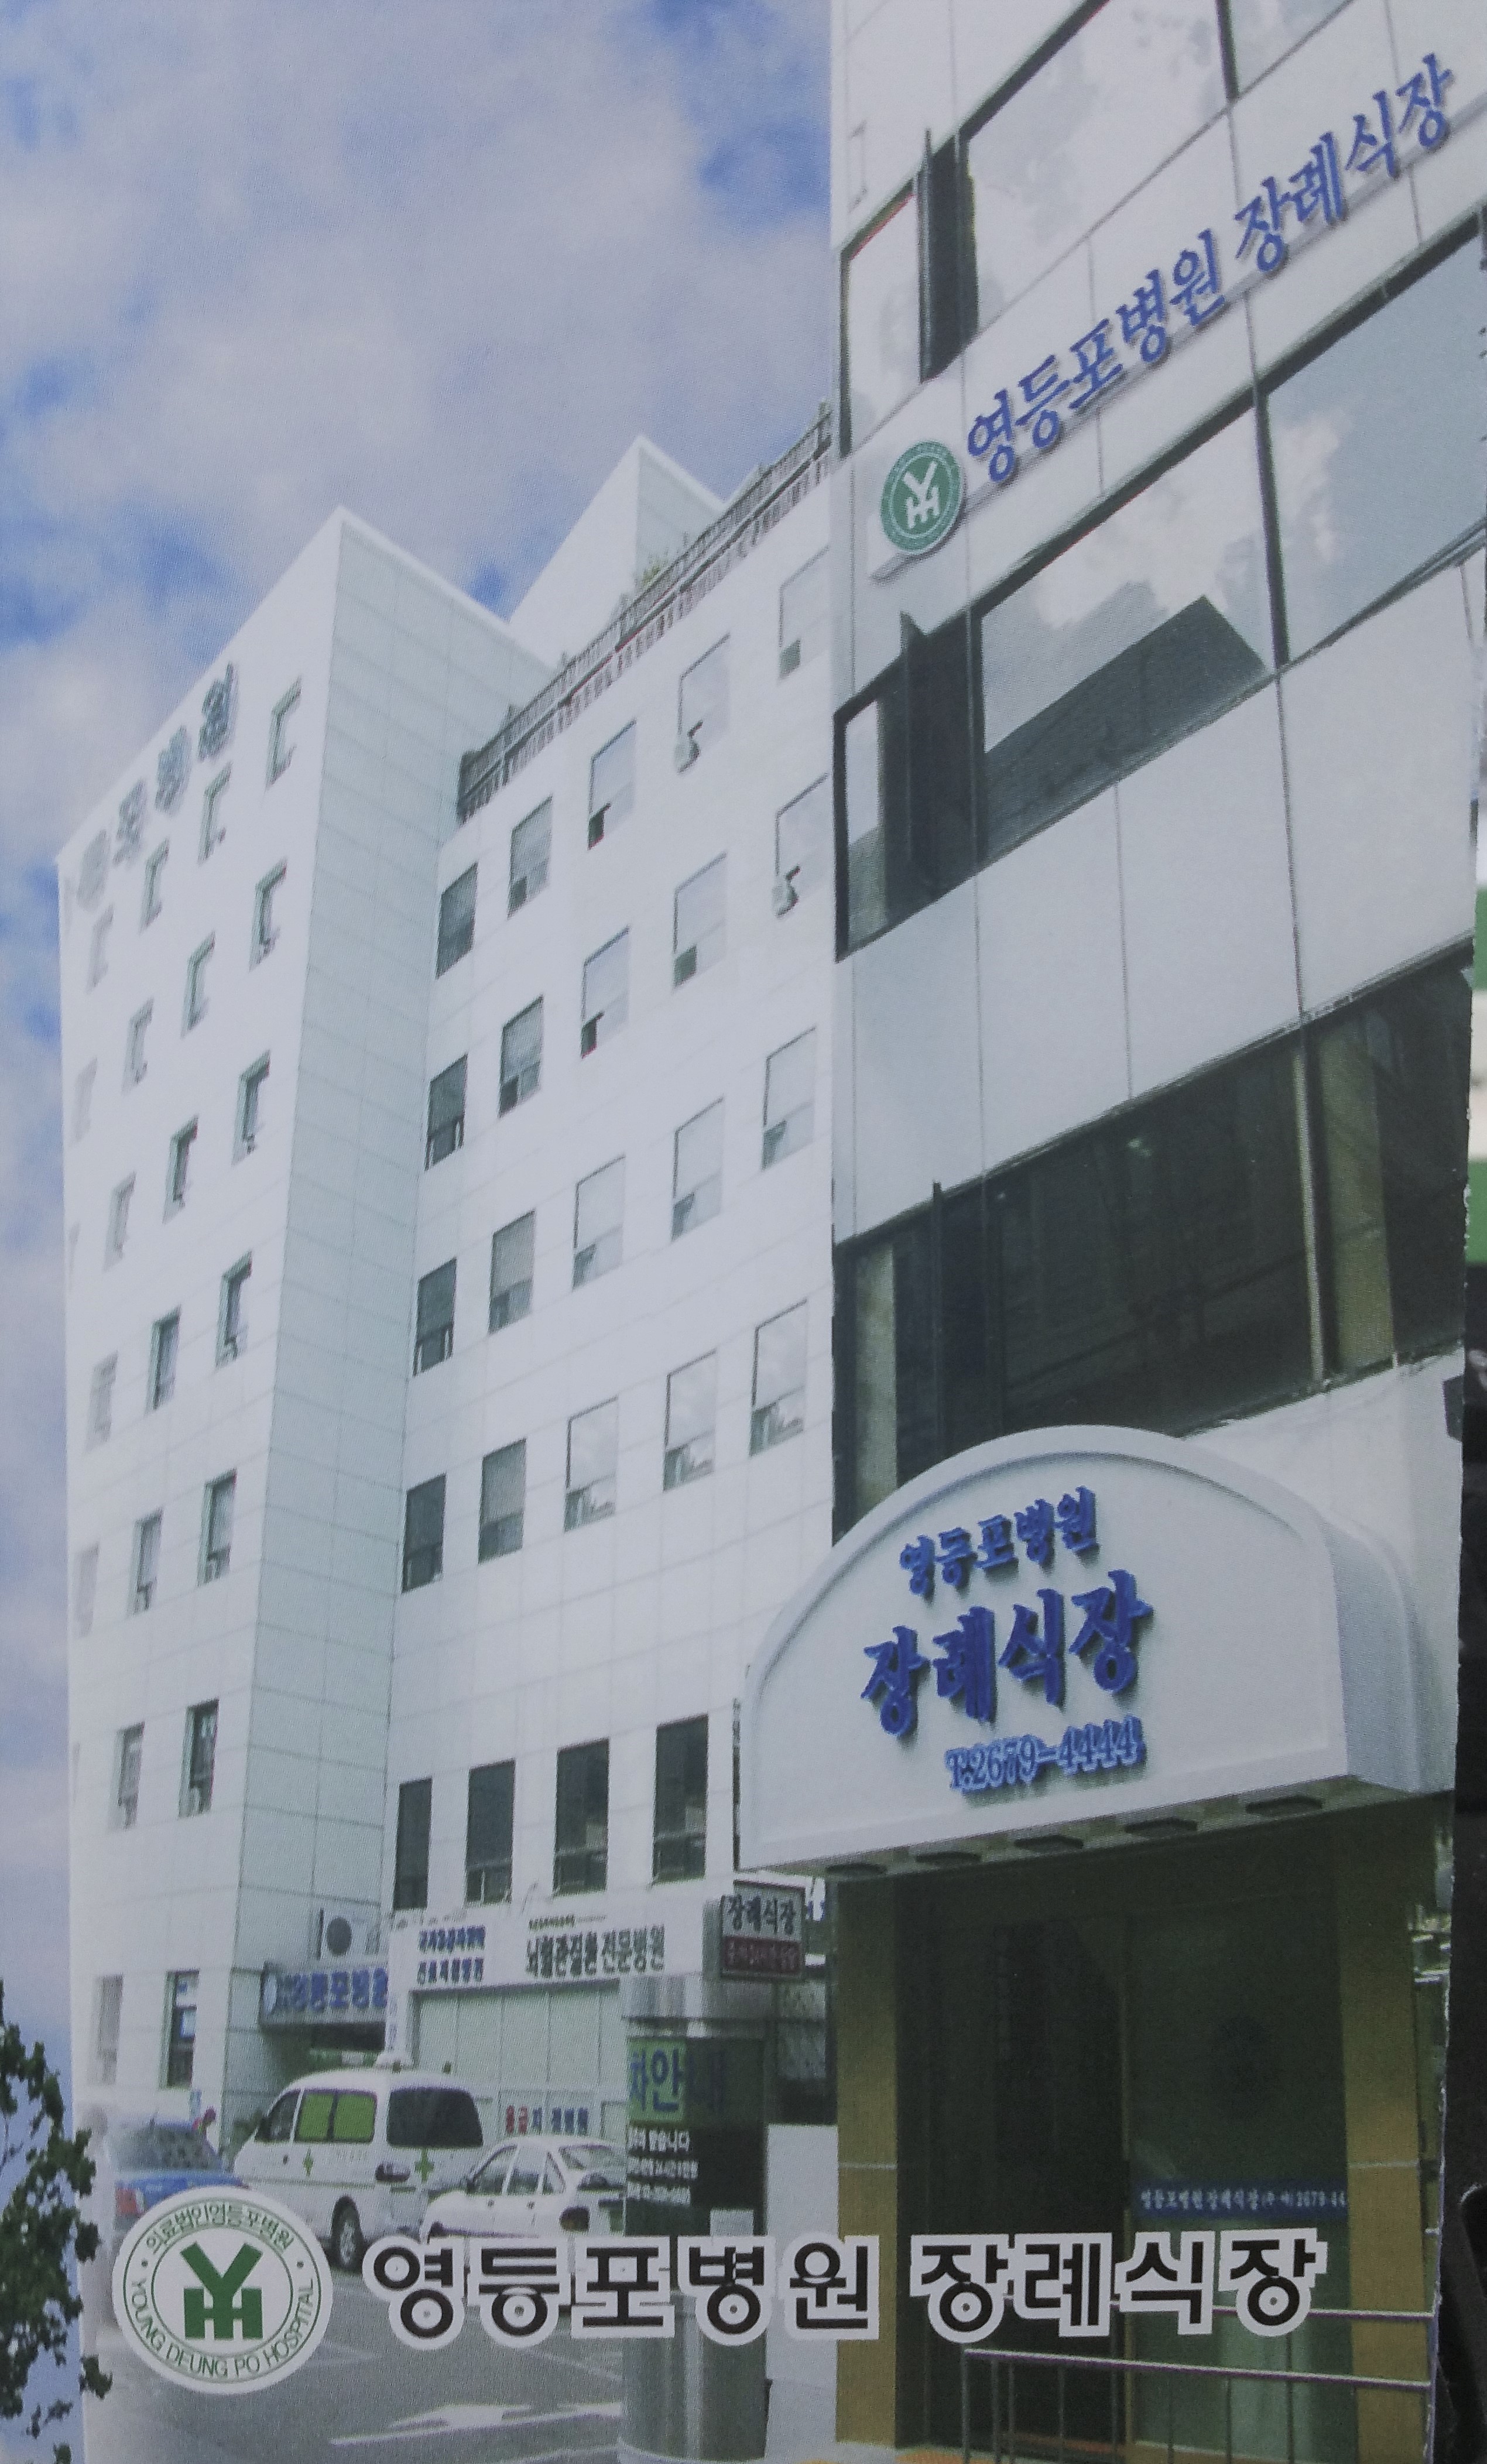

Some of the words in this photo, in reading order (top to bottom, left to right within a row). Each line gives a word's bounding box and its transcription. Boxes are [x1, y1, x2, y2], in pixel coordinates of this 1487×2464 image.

[967, 229, 1226, 484] 영등포병원
[1235, 53, 1452, 273] 장례식장
[899, 1486, 1098, 1596] 영등포병원
[861, 1569, 1153, 1736] 장례식장
[131, 2278, 166, 2351] YOUNG
[263, 2278, 313, 2367] HOSPITAL
[372, 2243, 869, 2338] 영등포병원
[921, 2238, 1317, 2332] 장례식장
